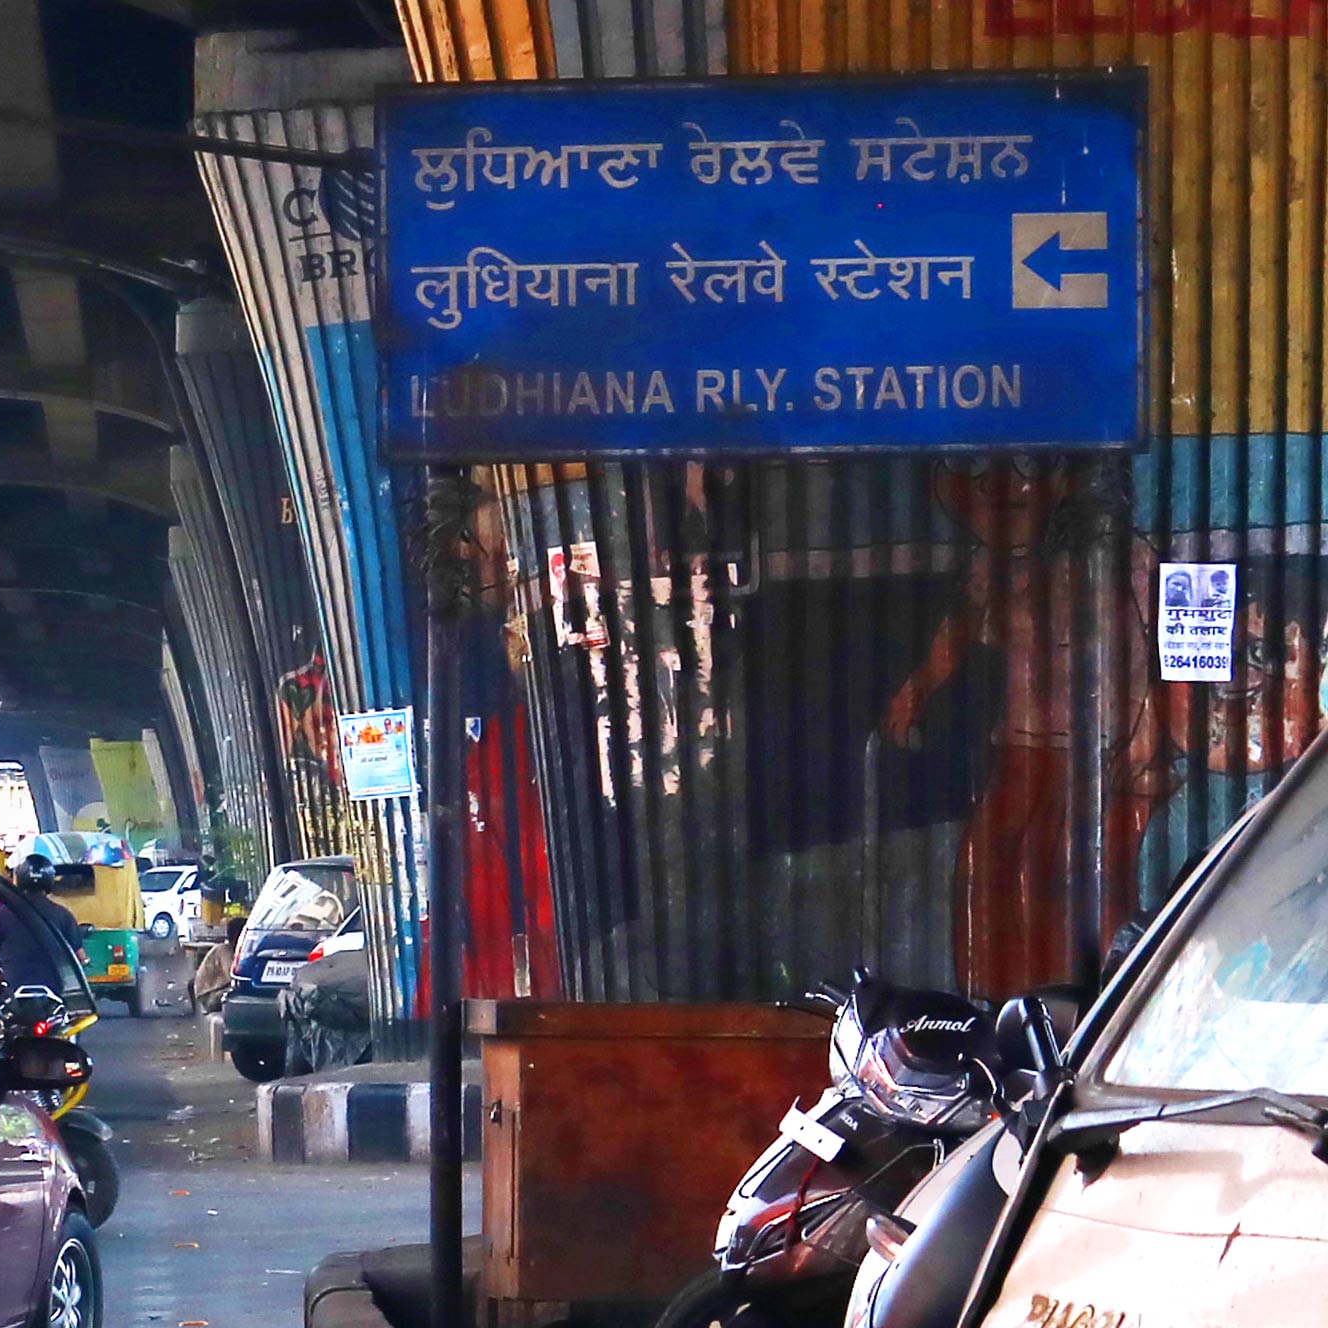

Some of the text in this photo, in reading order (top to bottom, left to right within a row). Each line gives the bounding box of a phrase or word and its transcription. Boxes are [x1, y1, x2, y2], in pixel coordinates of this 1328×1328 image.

[682, 119, 826, 185] ਰੇਲਵੇ
[411, 240, 976, 331] लुधियाना रेलवे स्टेशन
[696, 367, 794, 414] RLY.
[814, 363, 1022, 411] STATION
[899, 1014, 977, 1034] Anmol
